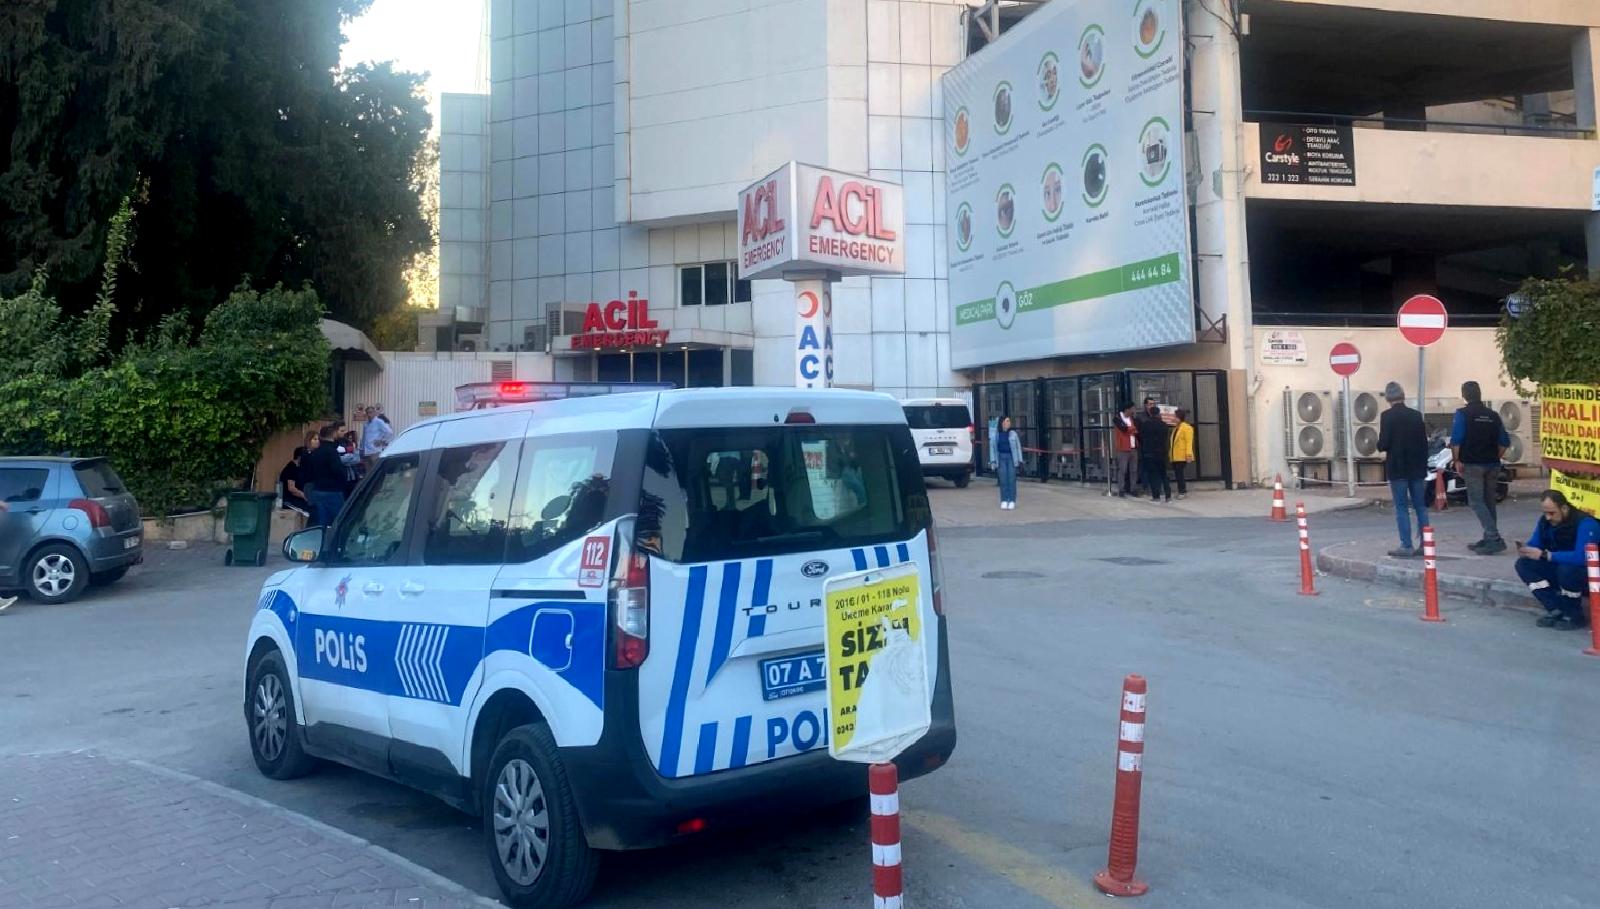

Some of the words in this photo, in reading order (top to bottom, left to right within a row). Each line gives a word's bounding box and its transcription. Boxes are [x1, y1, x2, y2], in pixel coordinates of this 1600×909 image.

[1265, 152, 1300, 166] Carstyle
[1268, 173, 1279, 181] 323
[1288, 174, 1299, 182] 323
[744, 235, 785, 269] EMERGENCY
[809, 235, 894, 264] EMERGENCY
[1132, 269, 1146, 282] 444
[1148, 268, 1158, 279] 44
[1161, 264, 1171, 275] 84
[1018, 292, 1033, 308] GÖZ
[571, 329, 670, 351] EMERGENCY
[1566, 439, 1582, 459] 622
[1584, 441, 1596, 461] 32
[586, 541, 605, 566] 112
[768, 663, 792, 686] 07
[799, 660, 812, 681] A
